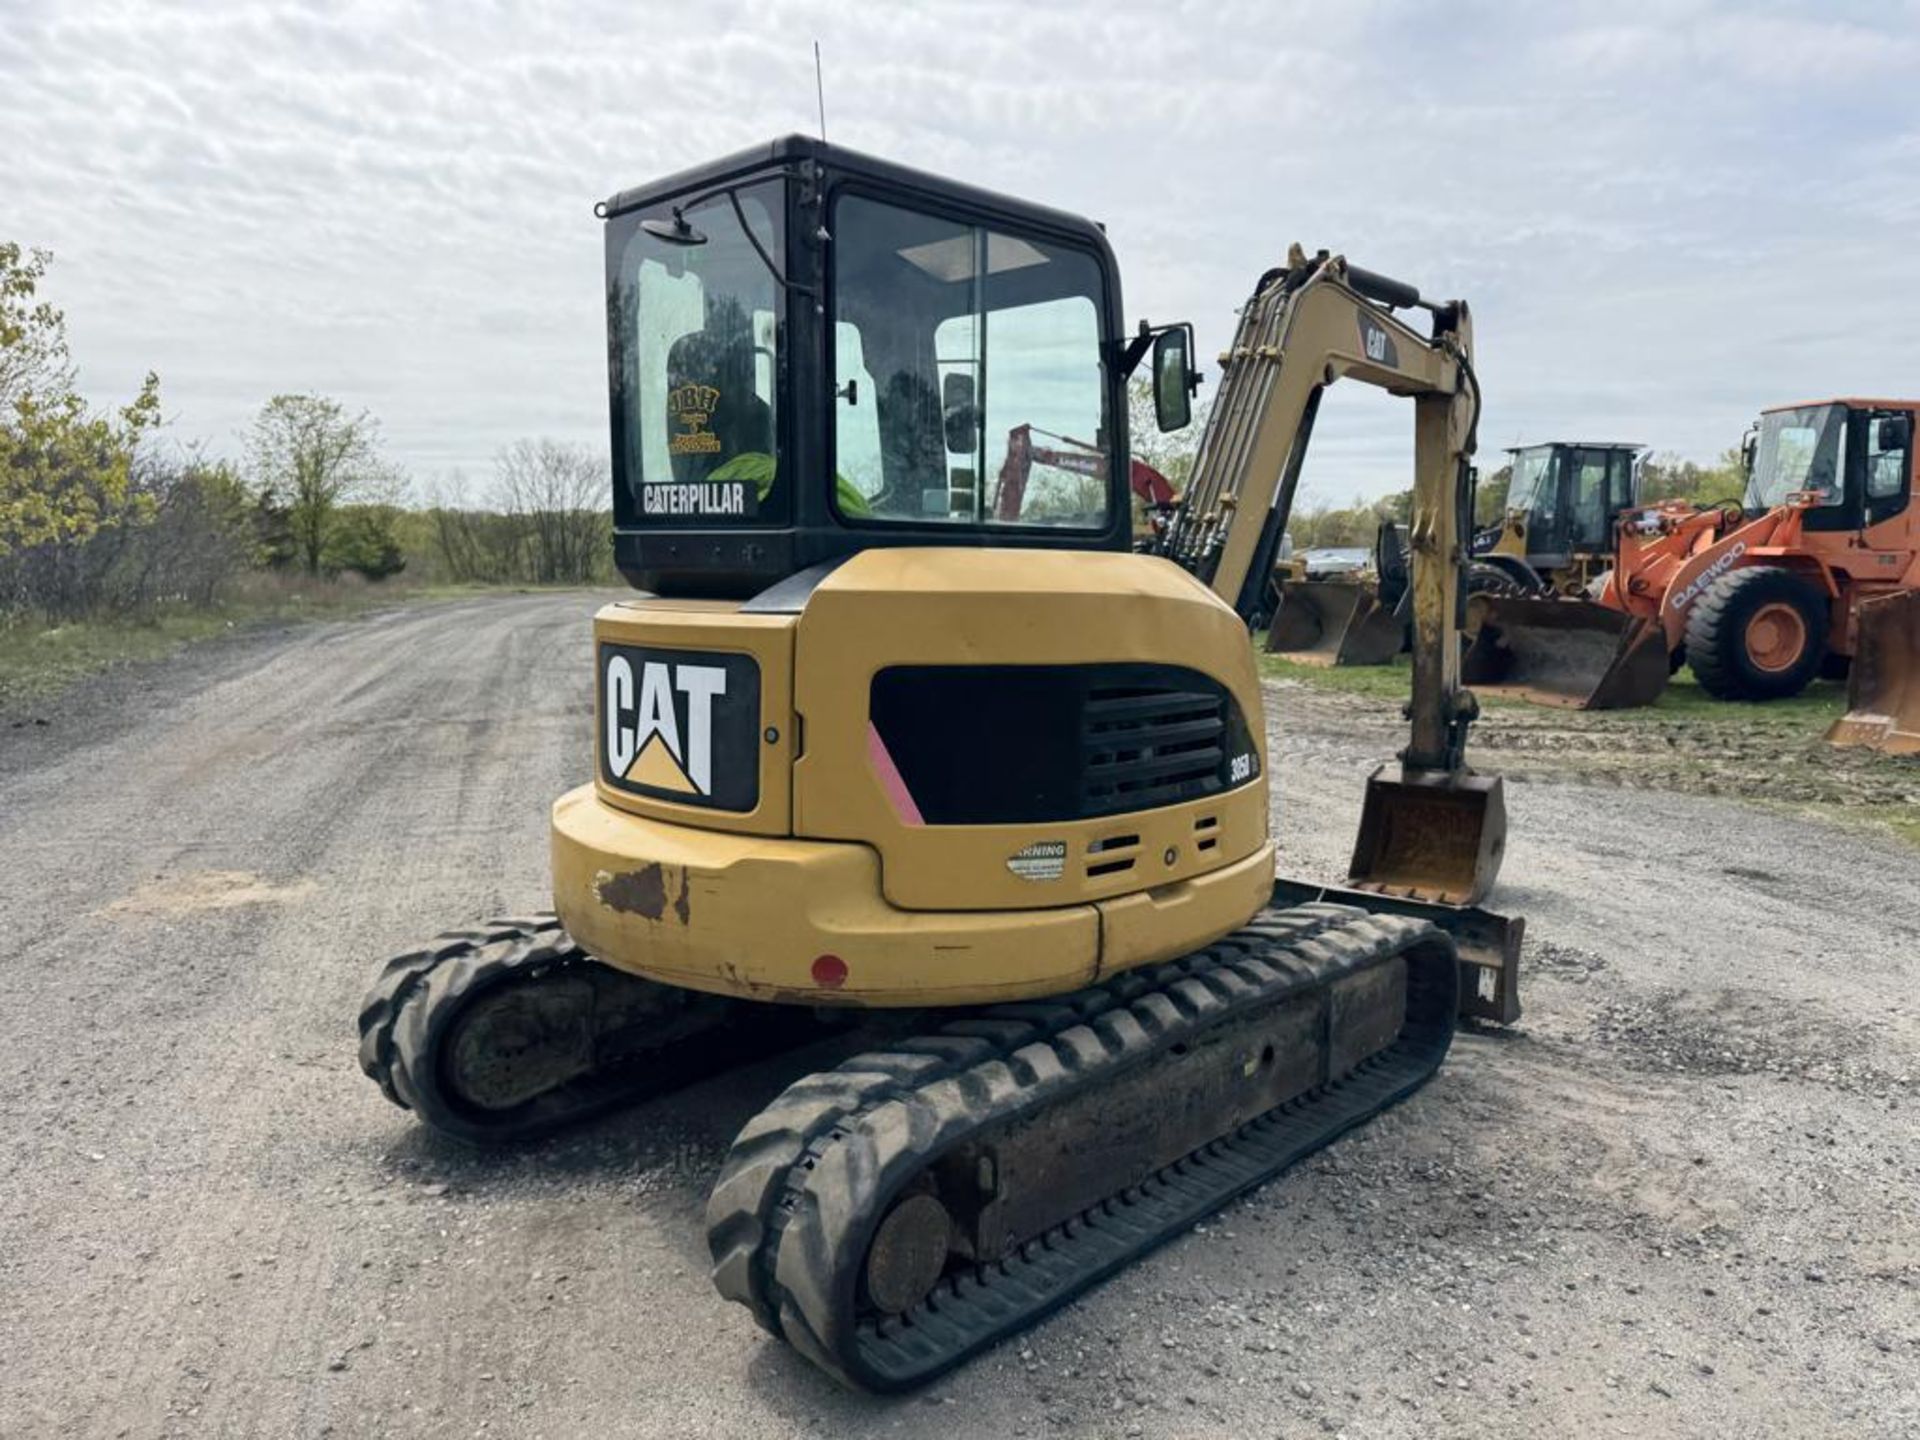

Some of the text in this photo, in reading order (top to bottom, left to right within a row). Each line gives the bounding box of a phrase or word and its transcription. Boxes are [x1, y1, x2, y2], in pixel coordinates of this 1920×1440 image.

[1366, 327, 1387, 361] CAT
[643, 483, 744, 514] CATERPILLAR
[1671, 541, 1746, 609] DAEWOO
[606, 655, 727, 796] CAT
[1018, 844, 1065, 857] RNING
